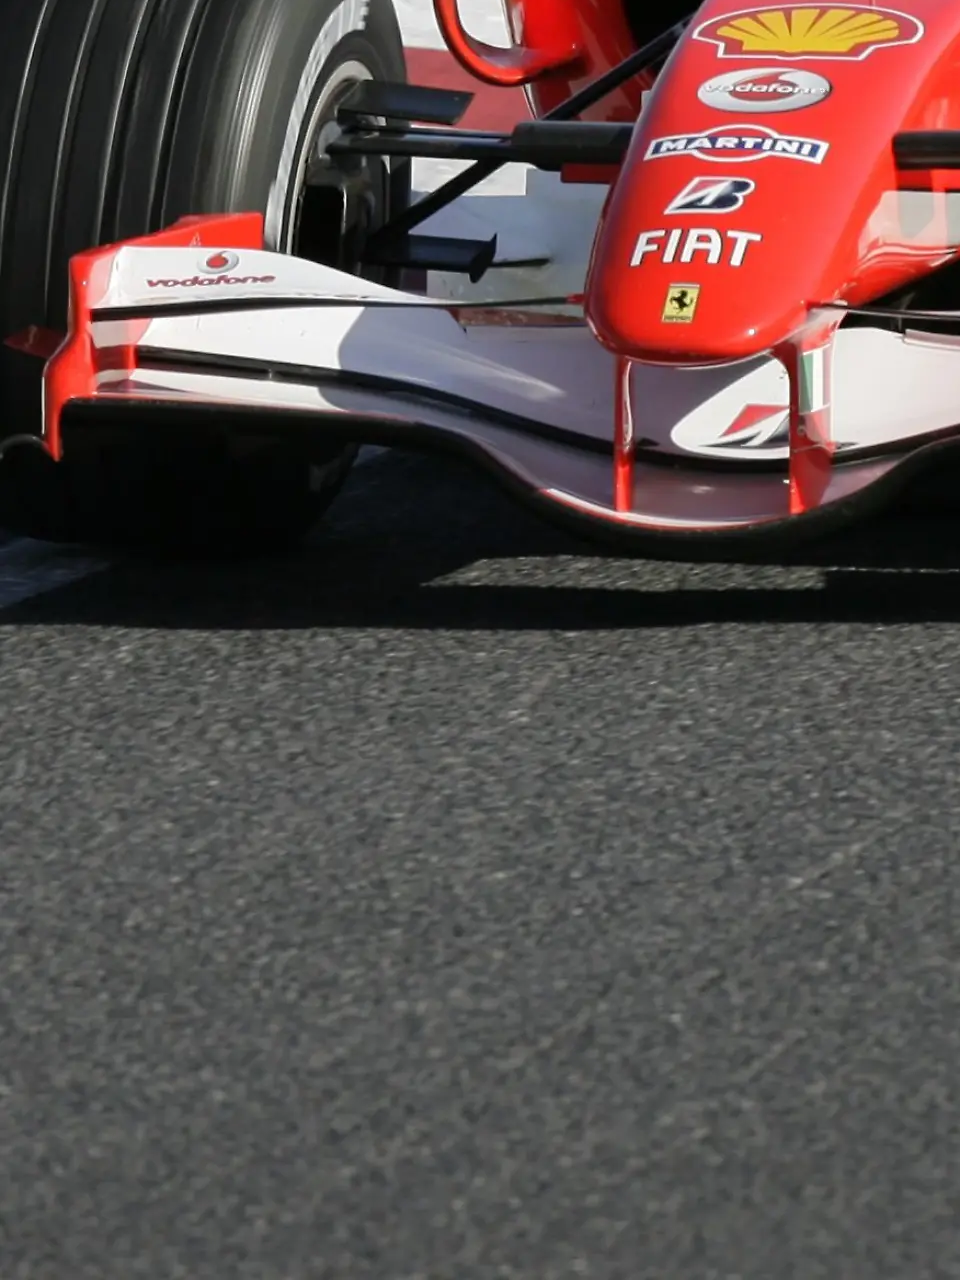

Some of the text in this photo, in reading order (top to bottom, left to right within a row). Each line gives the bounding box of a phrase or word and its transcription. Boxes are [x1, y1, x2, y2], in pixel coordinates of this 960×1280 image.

[660, 136, 812, 156] MARTINI
[630, 228, 762, 267] FIAT
[146, 274, 276, 288] vodafone
